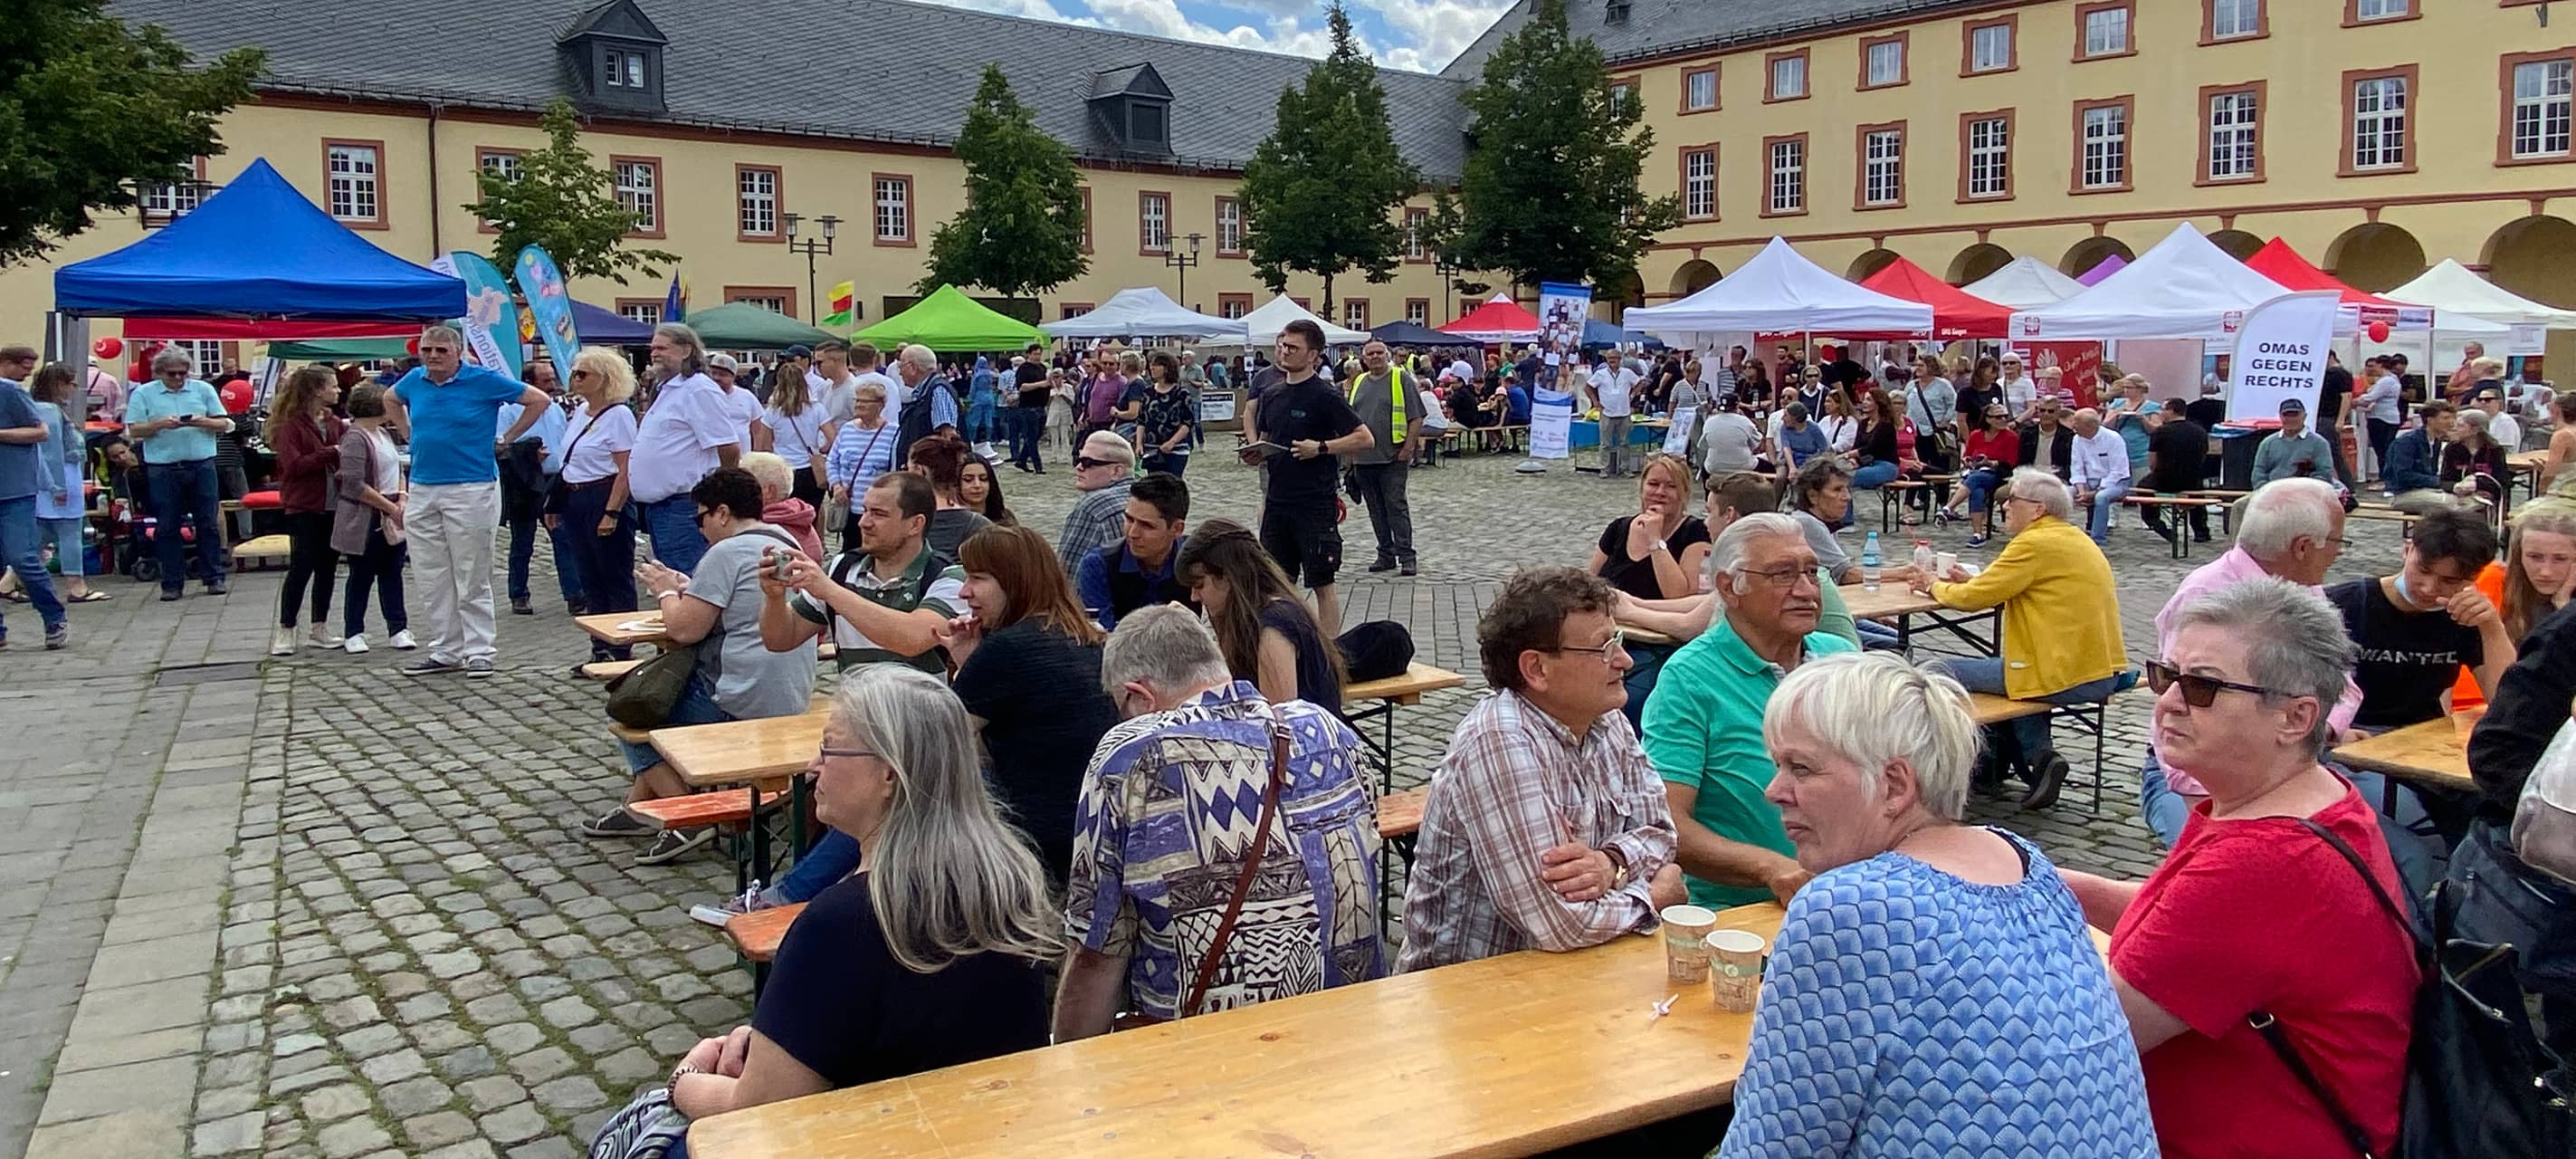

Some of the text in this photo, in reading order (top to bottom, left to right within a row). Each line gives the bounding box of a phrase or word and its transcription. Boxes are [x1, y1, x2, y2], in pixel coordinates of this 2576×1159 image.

[2258, 342, 2310, 355] OMAS
[2252, 359, 2312, 372] GEGEN
[2245, 375, 2314, 388] RECHTS
